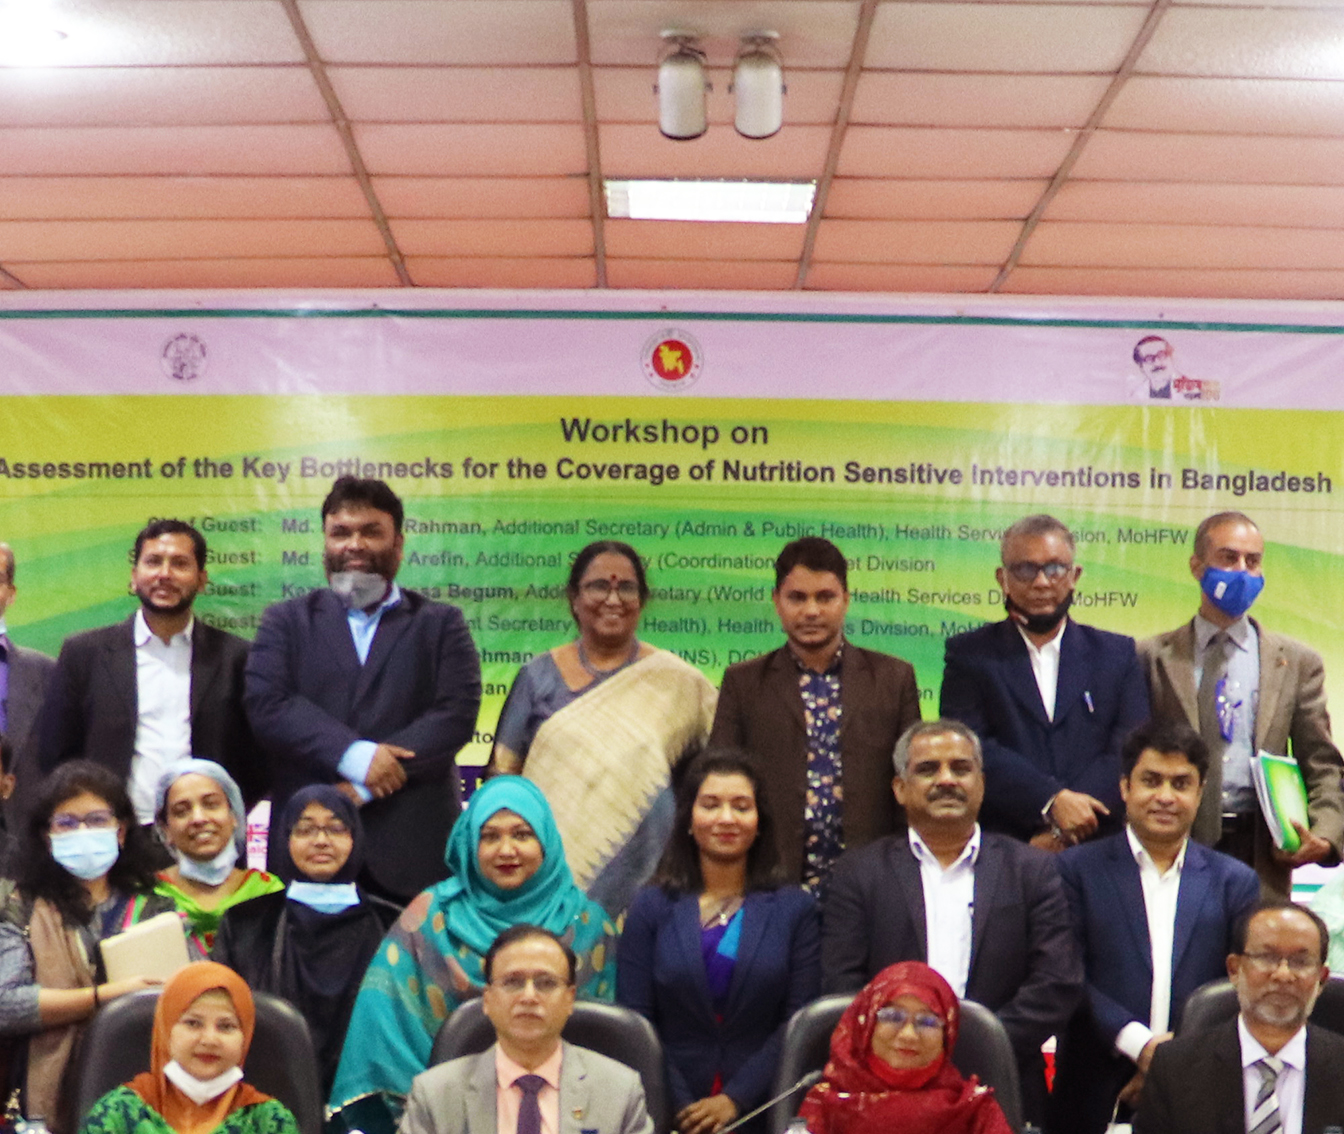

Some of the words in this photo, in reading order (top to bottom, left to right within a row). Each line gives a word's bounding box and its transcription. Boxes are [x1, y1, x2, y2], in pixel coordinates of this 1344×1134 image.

[560, 418, 719, 449] Workshop
[731, 425, 769, 444] on
[160, 457, 186, 478] of
[193, 458, 234, 478] the
[242, 457, 291, 483] Key
[300, 457, 454, 479] Bottlenecks
[463, 457, 499, 478] for
[507, 458, 547, 479] the
[556, 457, 680, 486] Coverage
[689, 459, 715, 480] of
[723, 460, 835, 482] Nutrition
[844, 462, 963, 485] Sensitive
[971, 464, 1141, 489] Interventions
[1150, 467, 1172, 489] in
[1181, 468, 1333, 496] Bangladesh
[201, 516, 262, 533] Guest:
[282, 518, 314, 533] Md.
[405, 519, 486, 537] Rahman,
[493, 519, 579, 536] Additional
[586, 519, 669, 539] Secretary
[676, 520, 737, 540] (Admin
[743, 522, 755, 537] &
[761, 521, 819, 538] Public
[822, 521, 888, 541] Health),
[895, 524, 952, 540] Health
[1117, 528, 1188, 544] MoHFW
[409, 551, 469, 569] Arefin,
[475, 551, 562, 567] Additional
[868, 555, 935, 572] Division
[448, 583, 518, 602] Begum,
[708, 586, 765, 604] (World
[907, 588, 981, 605] Services
[488, 616, 572, 634] Secretary
[643, 617, 712, 635] Health),
[718, 617, 774, 634] Health
[861, 619, 934, 638] Division,
